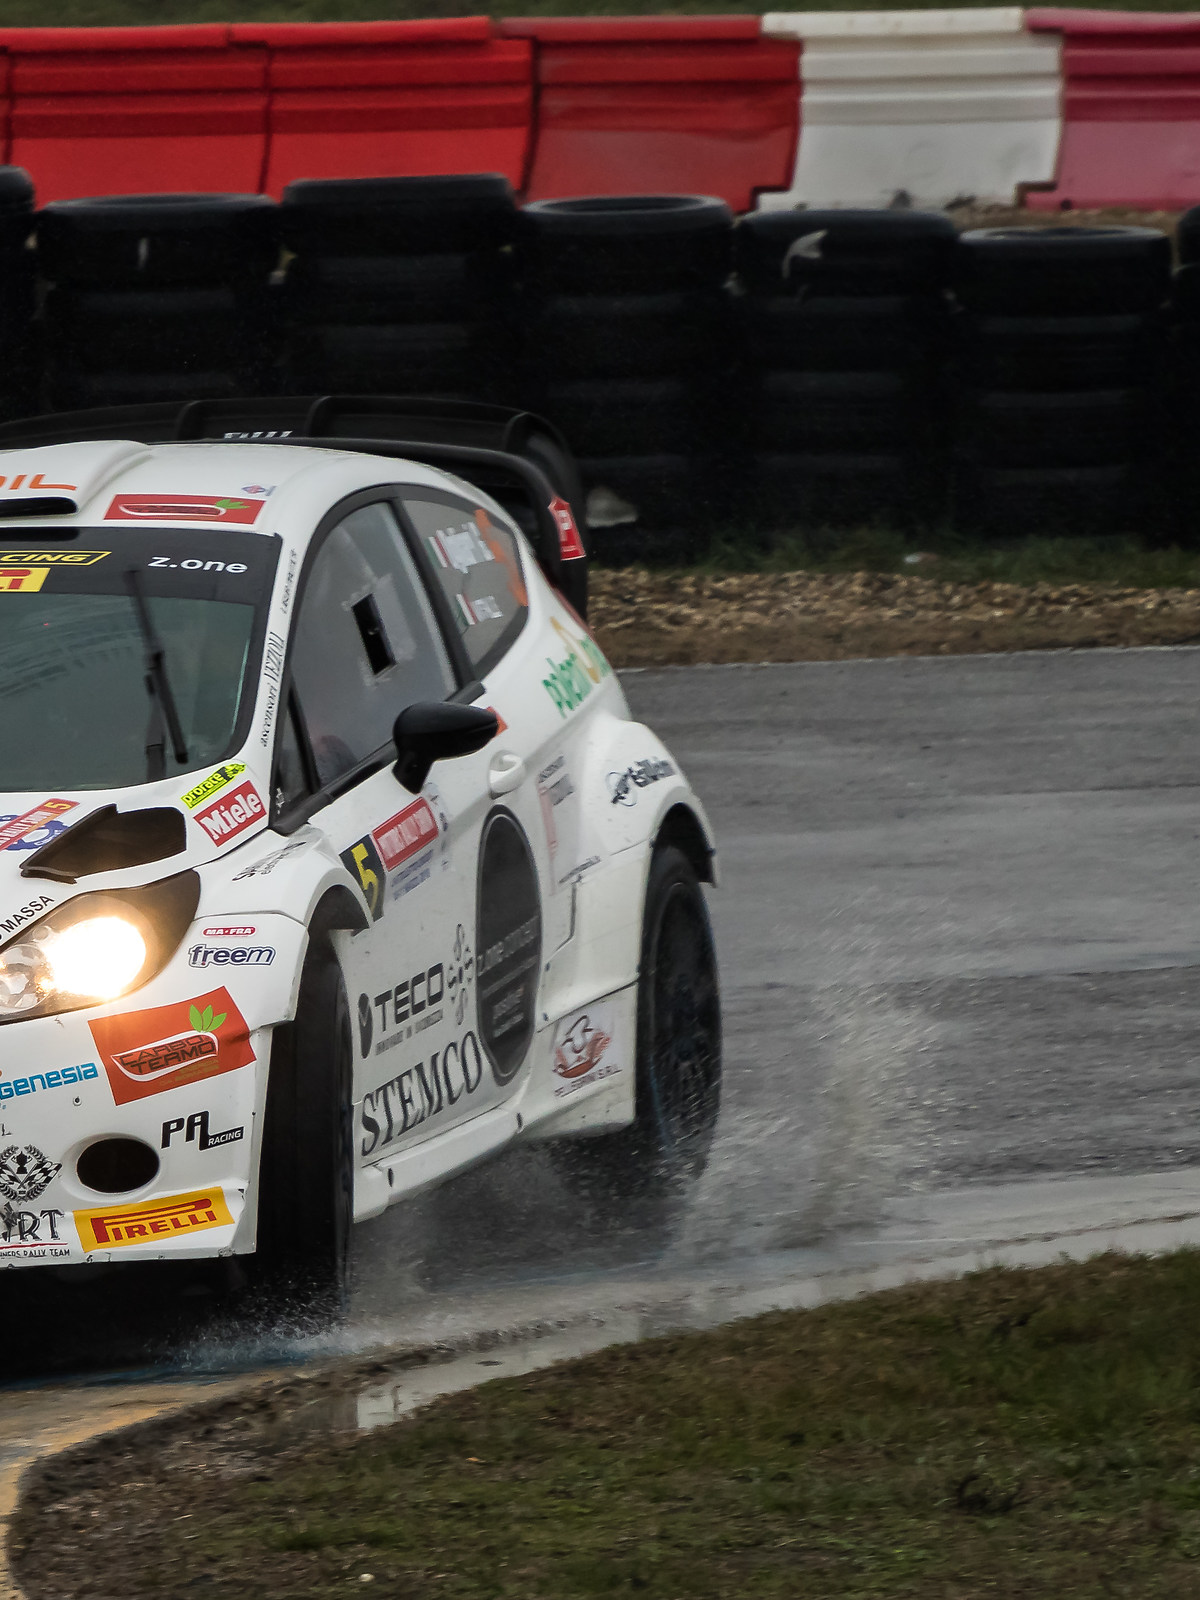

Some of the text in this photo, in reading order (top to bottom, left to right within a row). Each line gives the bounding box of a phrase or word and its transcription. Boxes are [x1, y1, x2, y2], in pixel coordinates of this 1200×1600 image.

[147, 556, 248, 574] z.one
[44, 801, 71, 810] 5
[199, 792, 262, 841] Miele
[0, 895, 55, 933] MASSA
[191, 945, 274, 966] freem
[374, 962, 443, 1032] TECO
[118, 1035, 205, 1066] CARBO
[130, 1041, 215, 1074] TERMO
[361, 1031, 482, 1157] STEMCO
[208, 1129, 242, 1147] RACING
[90, 1198, 217, 1244] PIRELLI
[49, 1248, 71, 1257] TEAM
